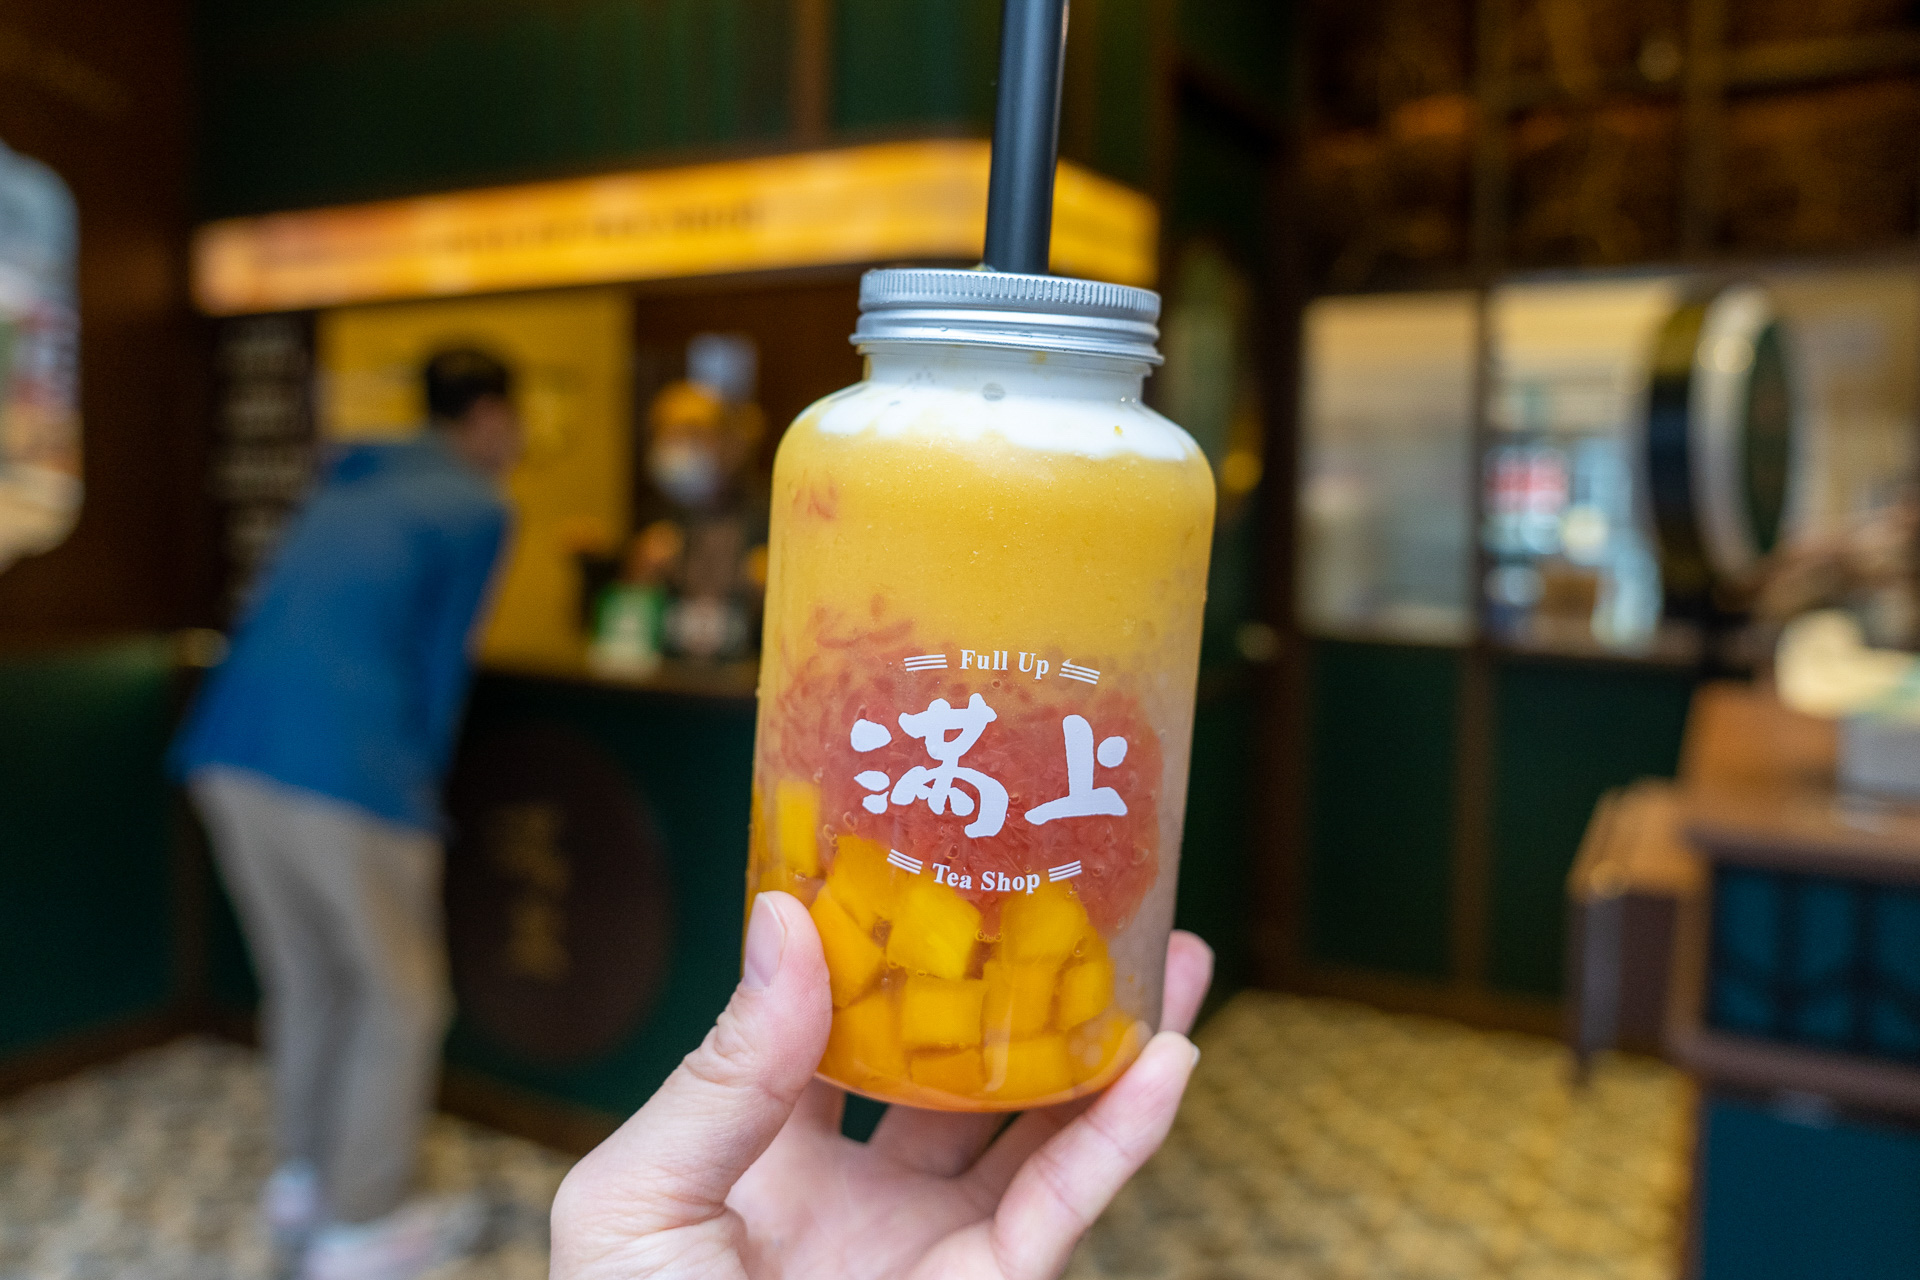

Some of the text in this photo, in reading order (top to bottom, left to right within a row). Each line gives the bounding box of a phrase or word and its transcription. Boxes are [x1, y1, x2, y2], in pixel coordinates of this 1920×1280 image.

[959, 649, 1050, 679] Full Up
[932, 863, 1041, 894] Tea Shop
